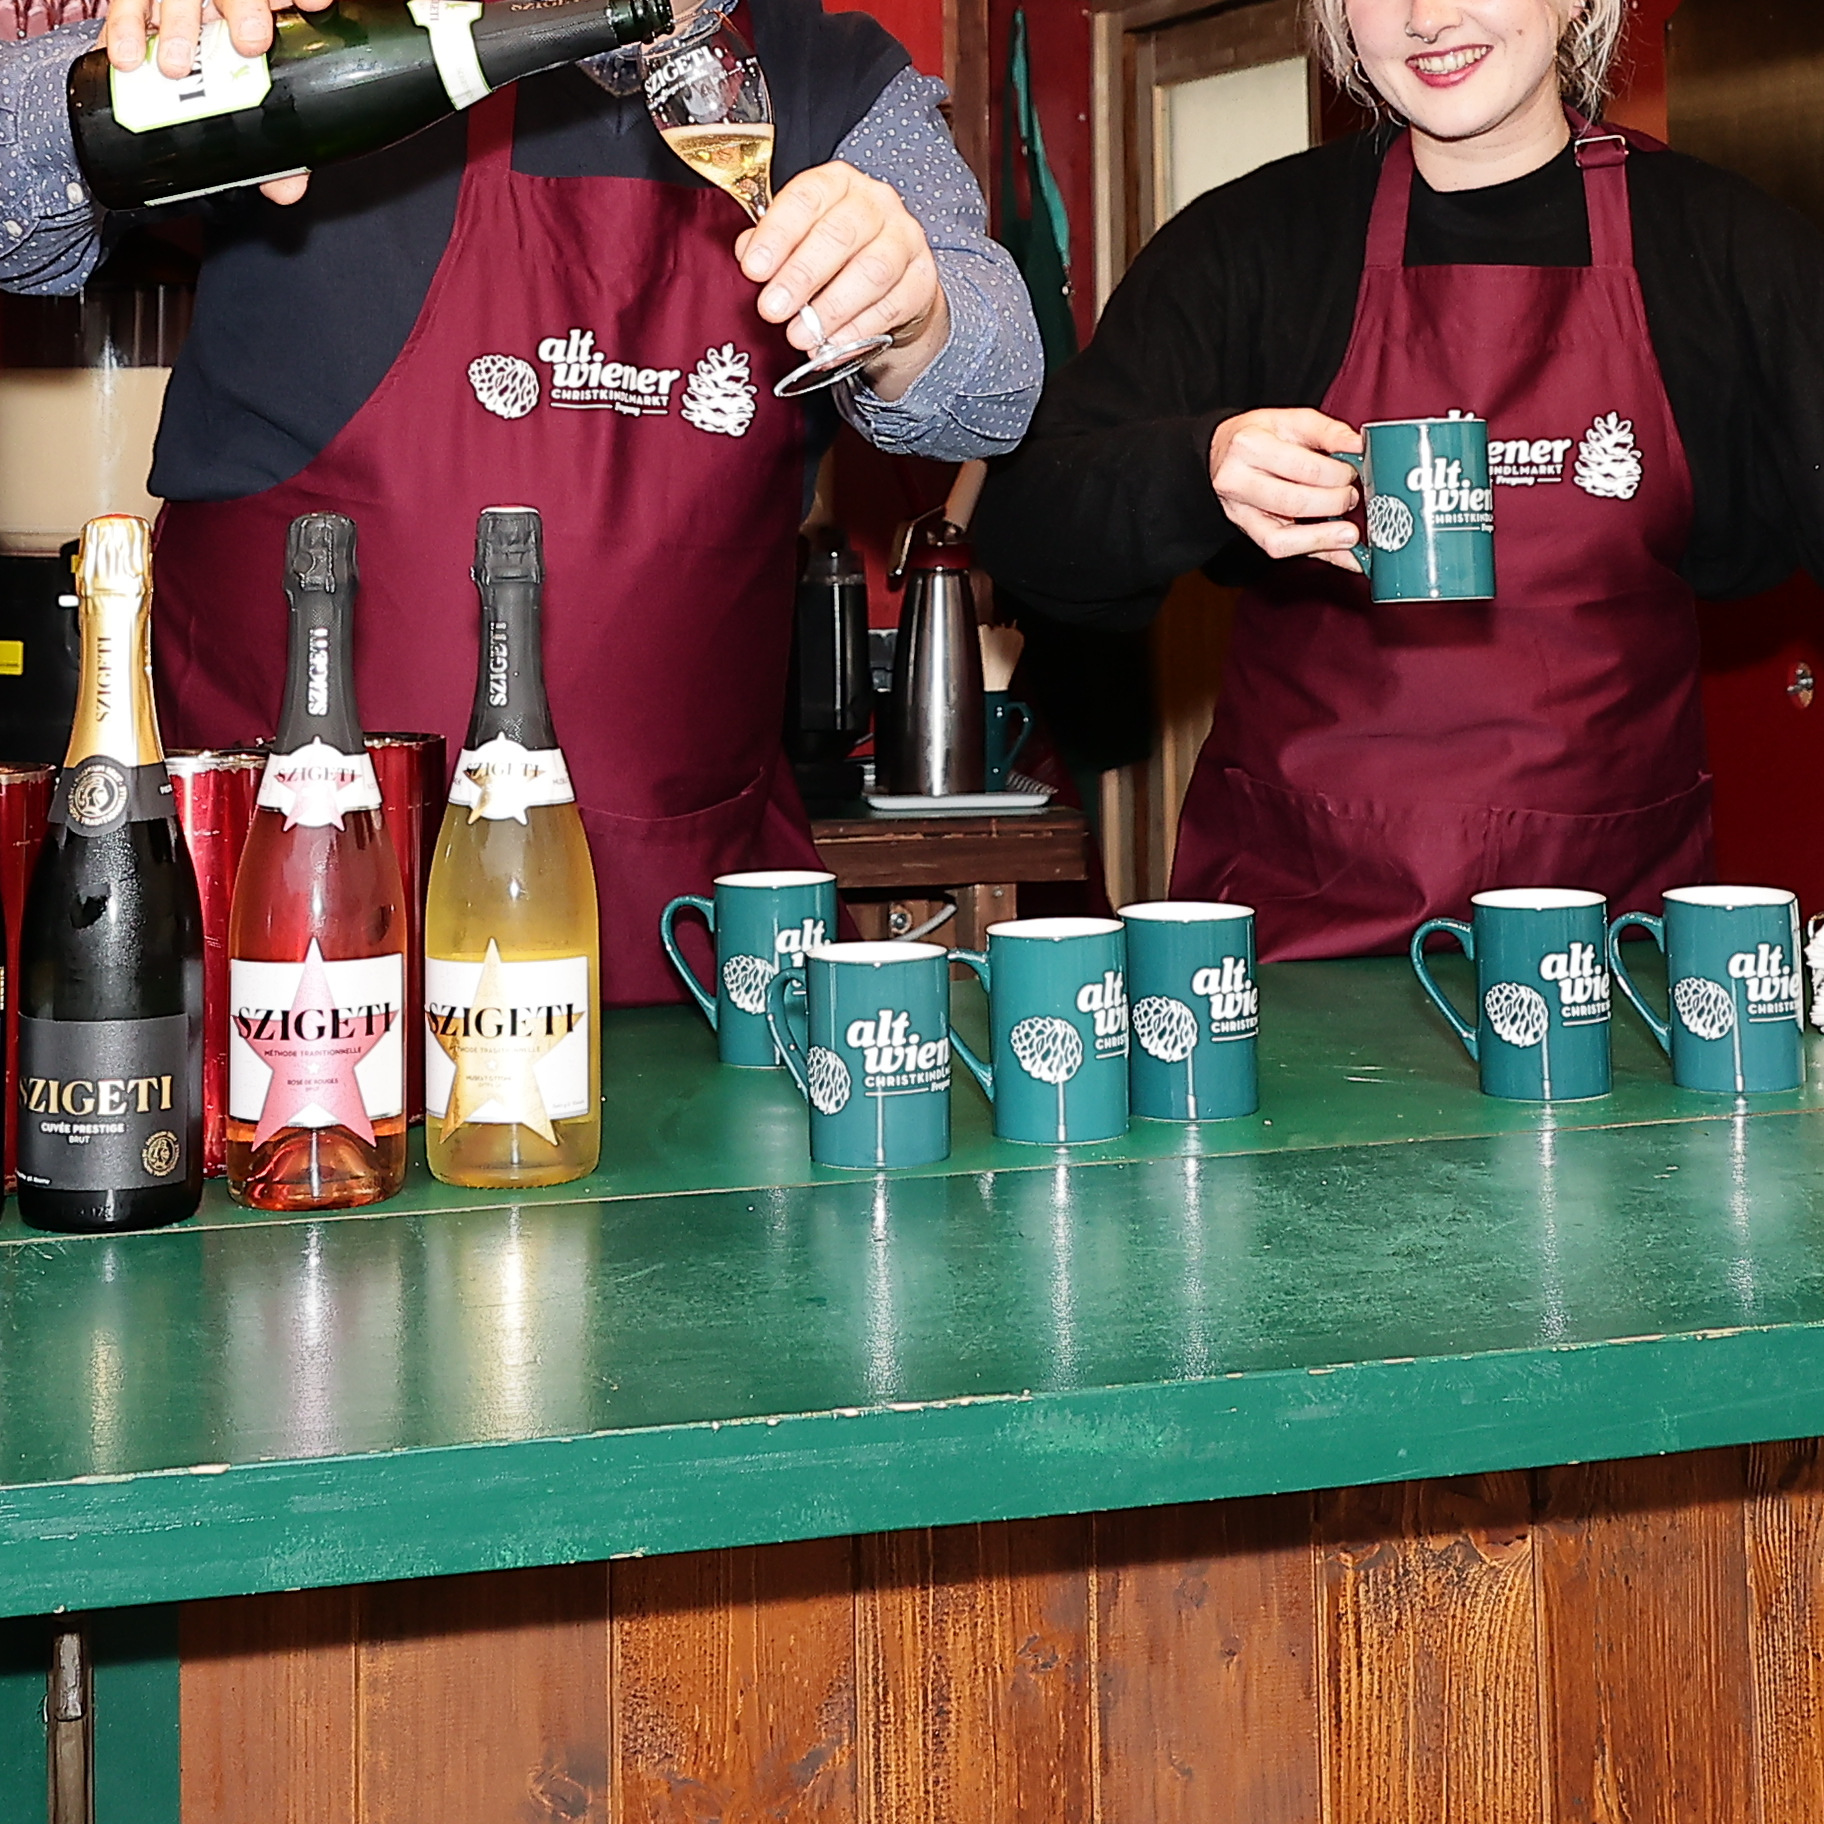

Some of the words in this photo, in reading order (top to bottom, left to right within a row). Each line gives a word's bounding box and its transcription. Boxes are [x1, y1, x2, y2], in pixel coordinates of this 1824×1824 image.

[644, 44, 715, 99] SZIGETI
[552, 361, 681, 395] wiener
[1487, 439, 1572, 464] ener
[94, 635, 113, 723] SZIGETI
[307, 626, 329, 717] SZIGETI
[488, 621, 508, 707] SZIGETI
[277, 761, 357, 783] SZIGETI
[237, 1001, 392, 1042] SZIGETI
[429, 1002, 575, 1039] SZIGETI
[846, 1009, 920, 1048] alt.
[19, 1075, 173, 1116] SZIGETI
